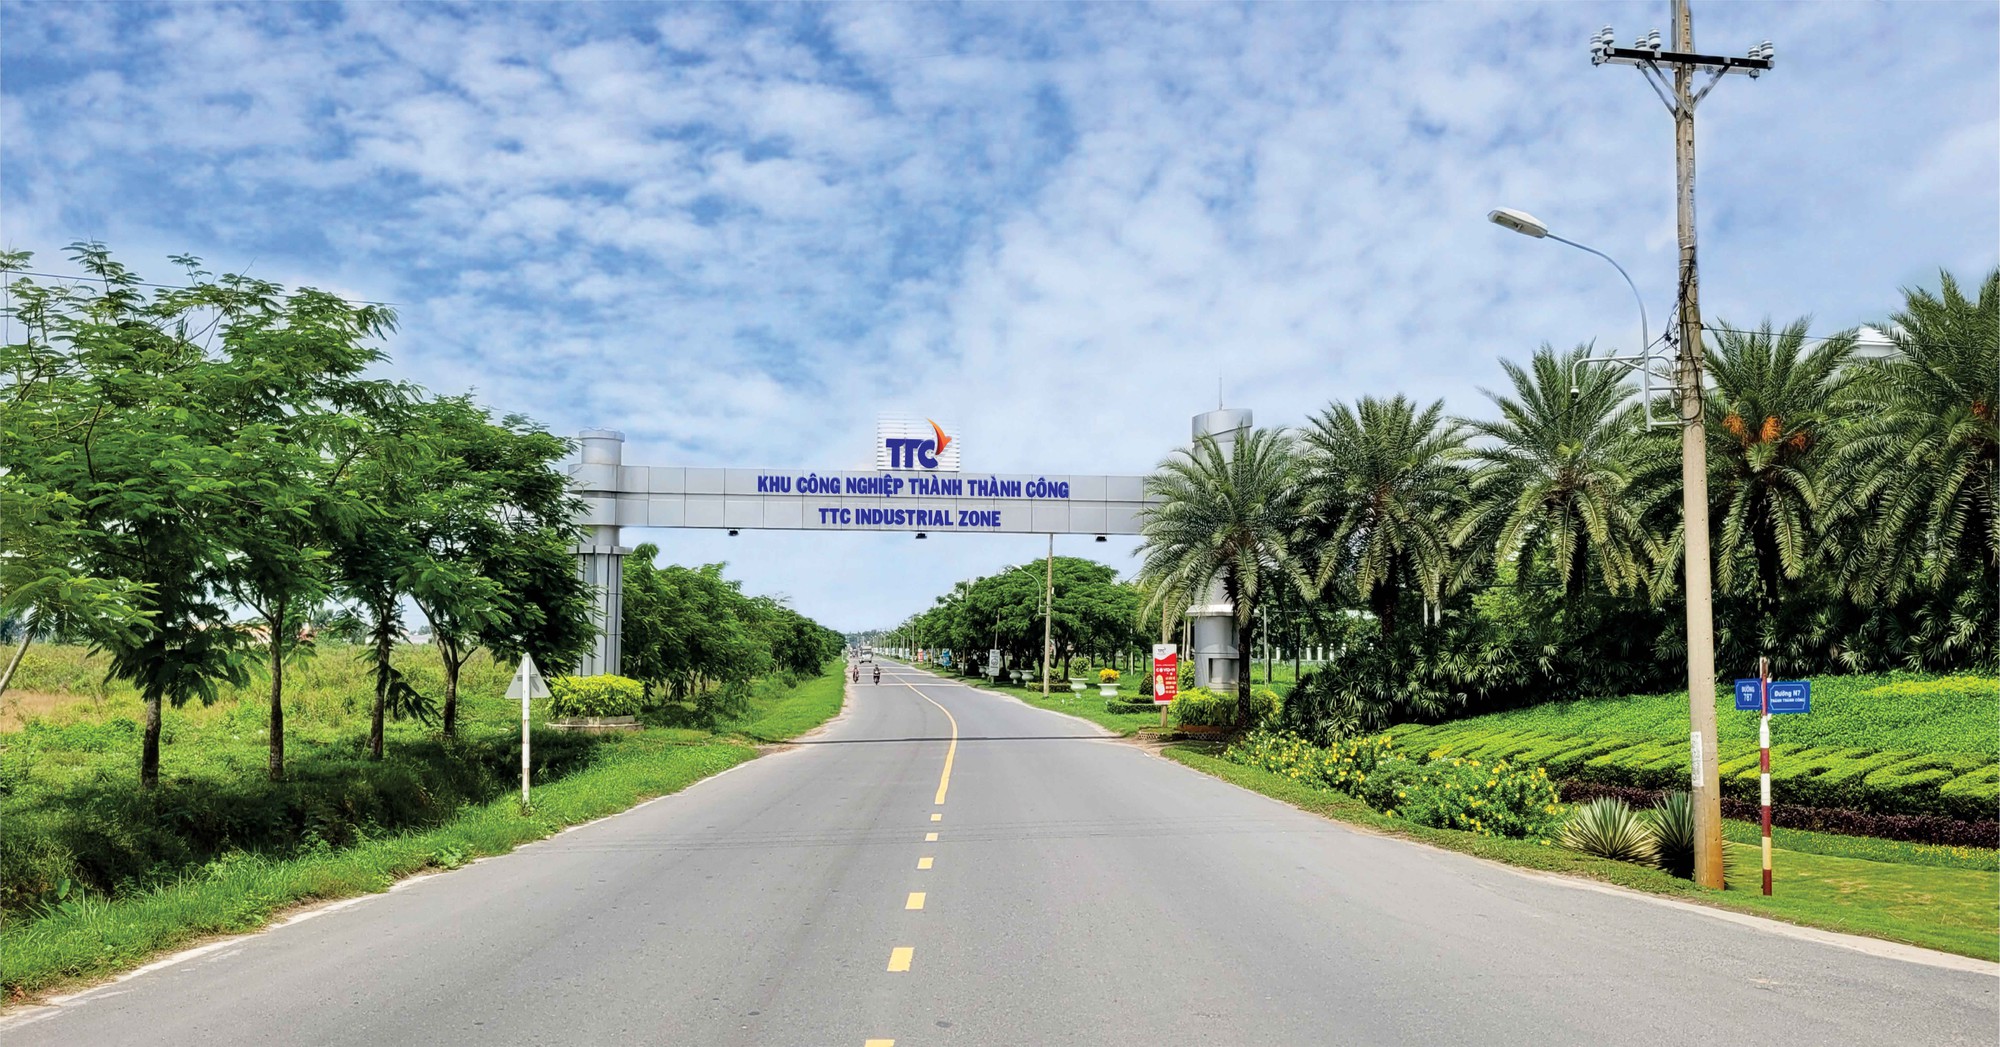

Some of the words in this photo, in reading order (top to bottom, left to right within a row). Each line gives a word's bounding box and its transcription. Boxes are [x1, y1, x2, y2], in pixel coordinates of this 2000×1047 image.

[885, 438, 939, 469] TTC
[757, 475, 791, 493] KHU
[796, 473, 841, 495] CÔNG
[846, 474, 904, 498] NGHIỆP
[908, 475, 963, 496] THÀNH
[967, 476, 1022, 497] THÀNH
[1025, 477, 1070, 499] CÔNG
[818, 507, 851, 525] TTC
[855, 508, 954, 527] INDUSTRIAL
[958, 510, 1001, 527] ZONE
